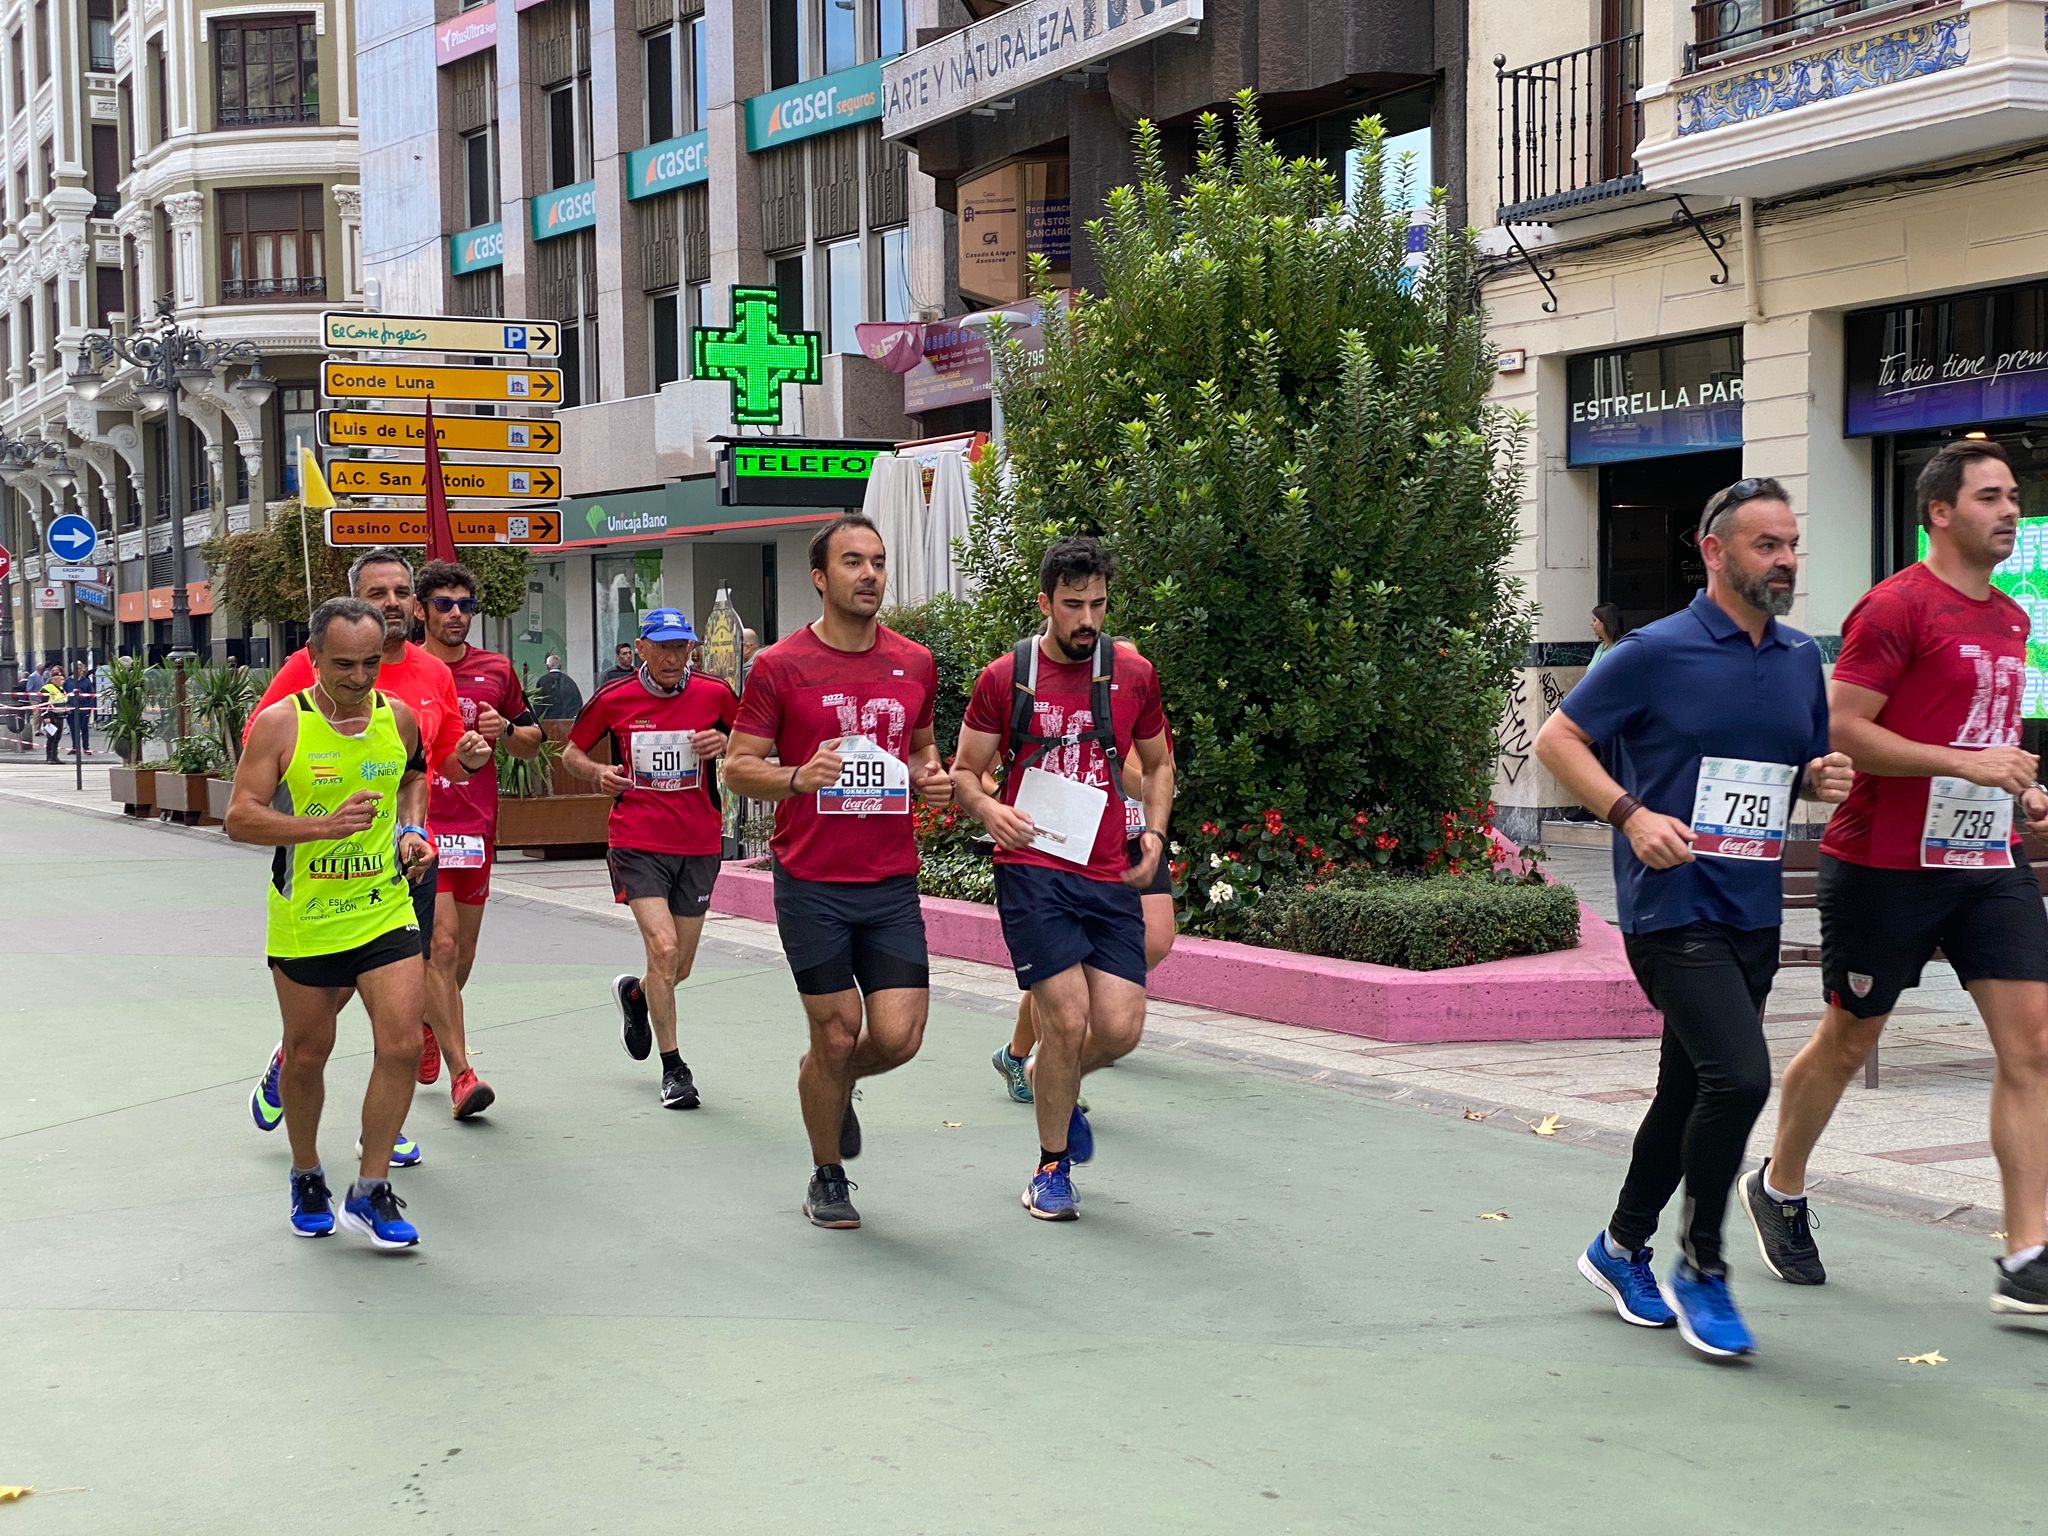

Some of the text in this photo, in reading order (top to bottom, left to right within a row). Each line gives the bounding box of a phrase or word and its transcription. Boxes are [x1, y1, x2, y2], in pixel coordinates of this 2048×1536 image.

[888, 68, 928, 118] ARTE
[933, 61, 945, 98] Y
[950, 7, 1077, 94] NATURALEZA
[781, 87, 876, 129] caser seguros
[656, 141, 704, 180] caser
[332, 323, 346, 338] El
[346, 324, 379, 339] Corte
[1878, 352, 1906, 386] Tu
[1901, 358, 1934, 383] ocio
[1942, 353, 1985, 378] tiene
[332, 373, 435, 389] Conde Luna
[1573, 378, 1743, 423] ESTRELLA PAR
[334, 421, 445, 439] Luis de Len
[736, 454, 874, 473] TELEFO
[336, 471, 485, 488] A.C. San tonio
[336, 521, 391, 534] casino
[458, 521, 496, 534] Luna
[607, 512, 642, 533] Unicaja
[821, 693, 844, 702] 2022
[652, 751, 681, 771] 501
[377, 768, 398, 776] NIEVE
[841, 761, 885, 787] 599
[1725, 792, 1770, 827] 739
[1951, 809, 1995, 839] 738
